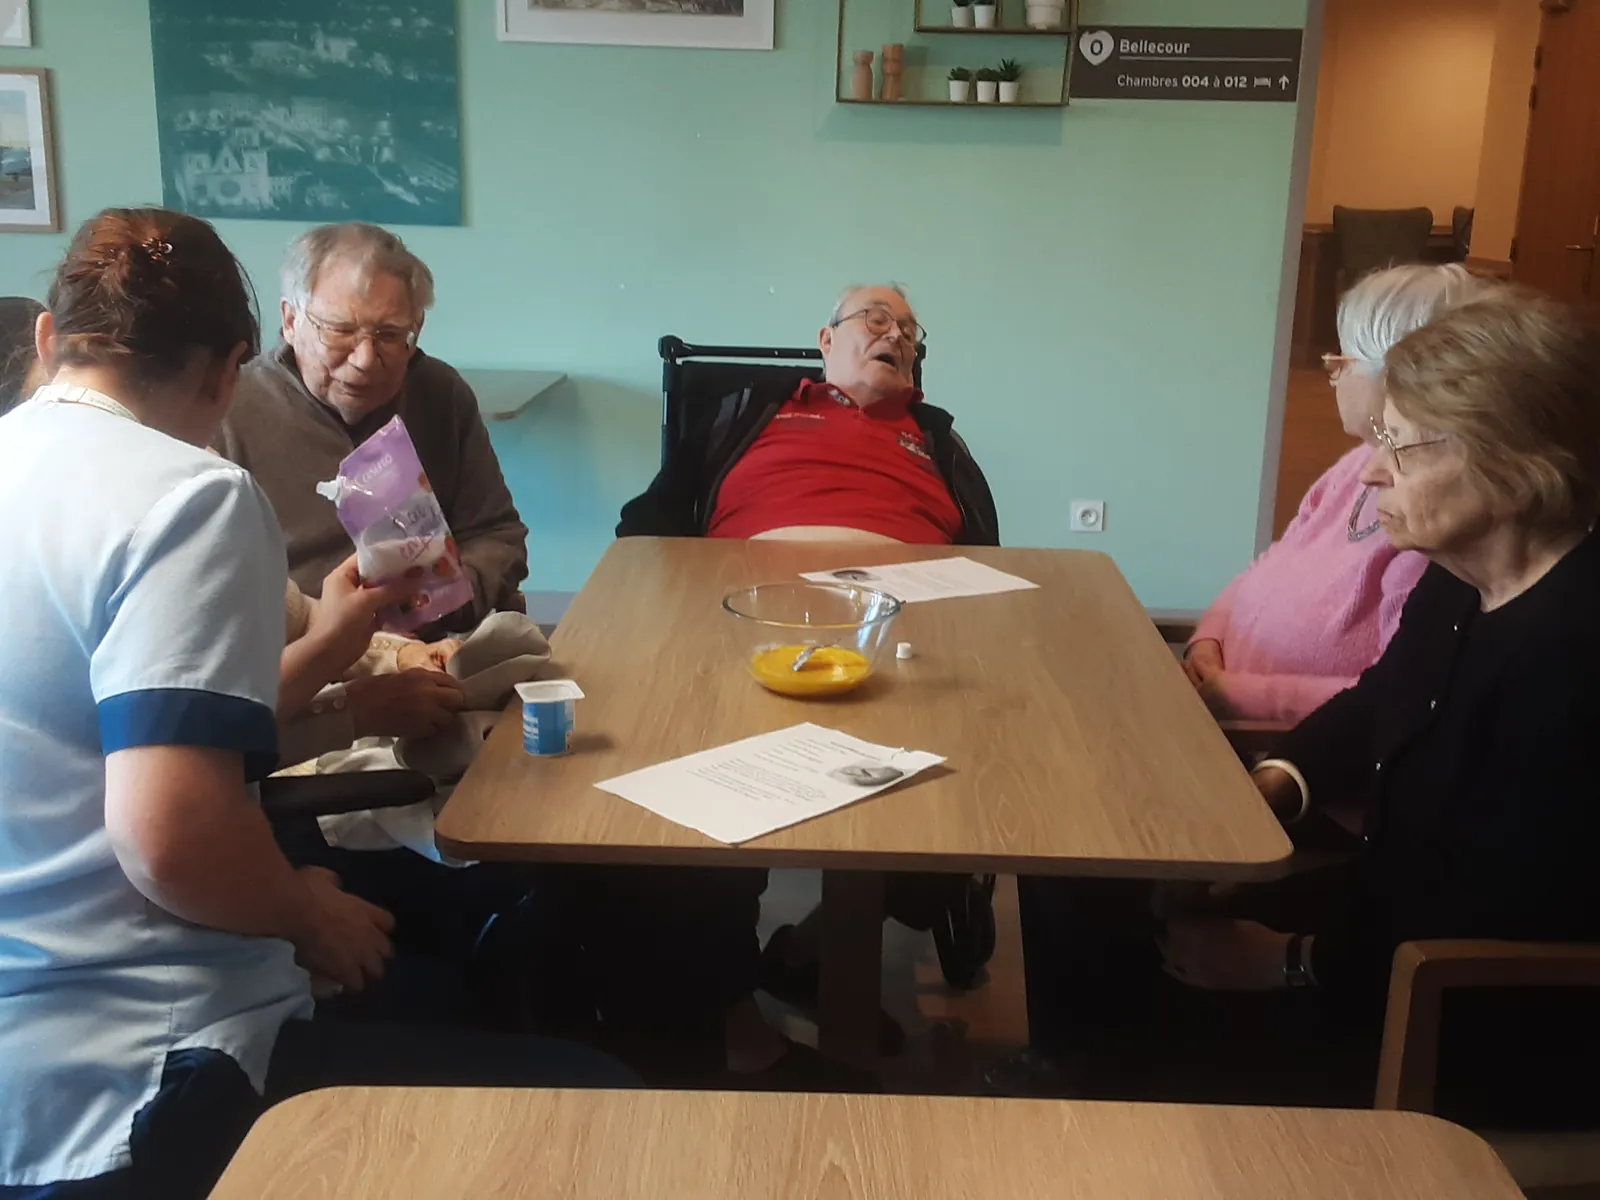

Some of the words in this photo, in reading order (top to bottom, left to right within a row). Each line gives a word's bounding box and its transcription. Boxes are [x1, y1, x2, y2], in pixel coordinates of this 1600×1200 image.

[1119, 38, 1190, 54] Bellecour
[1117, 74, 1178, 88] Chambres
[1181, 75, 1209, 88] 004
[1213, 75, 1220, 88] à
[1224, 75, 1248, 88] 012
